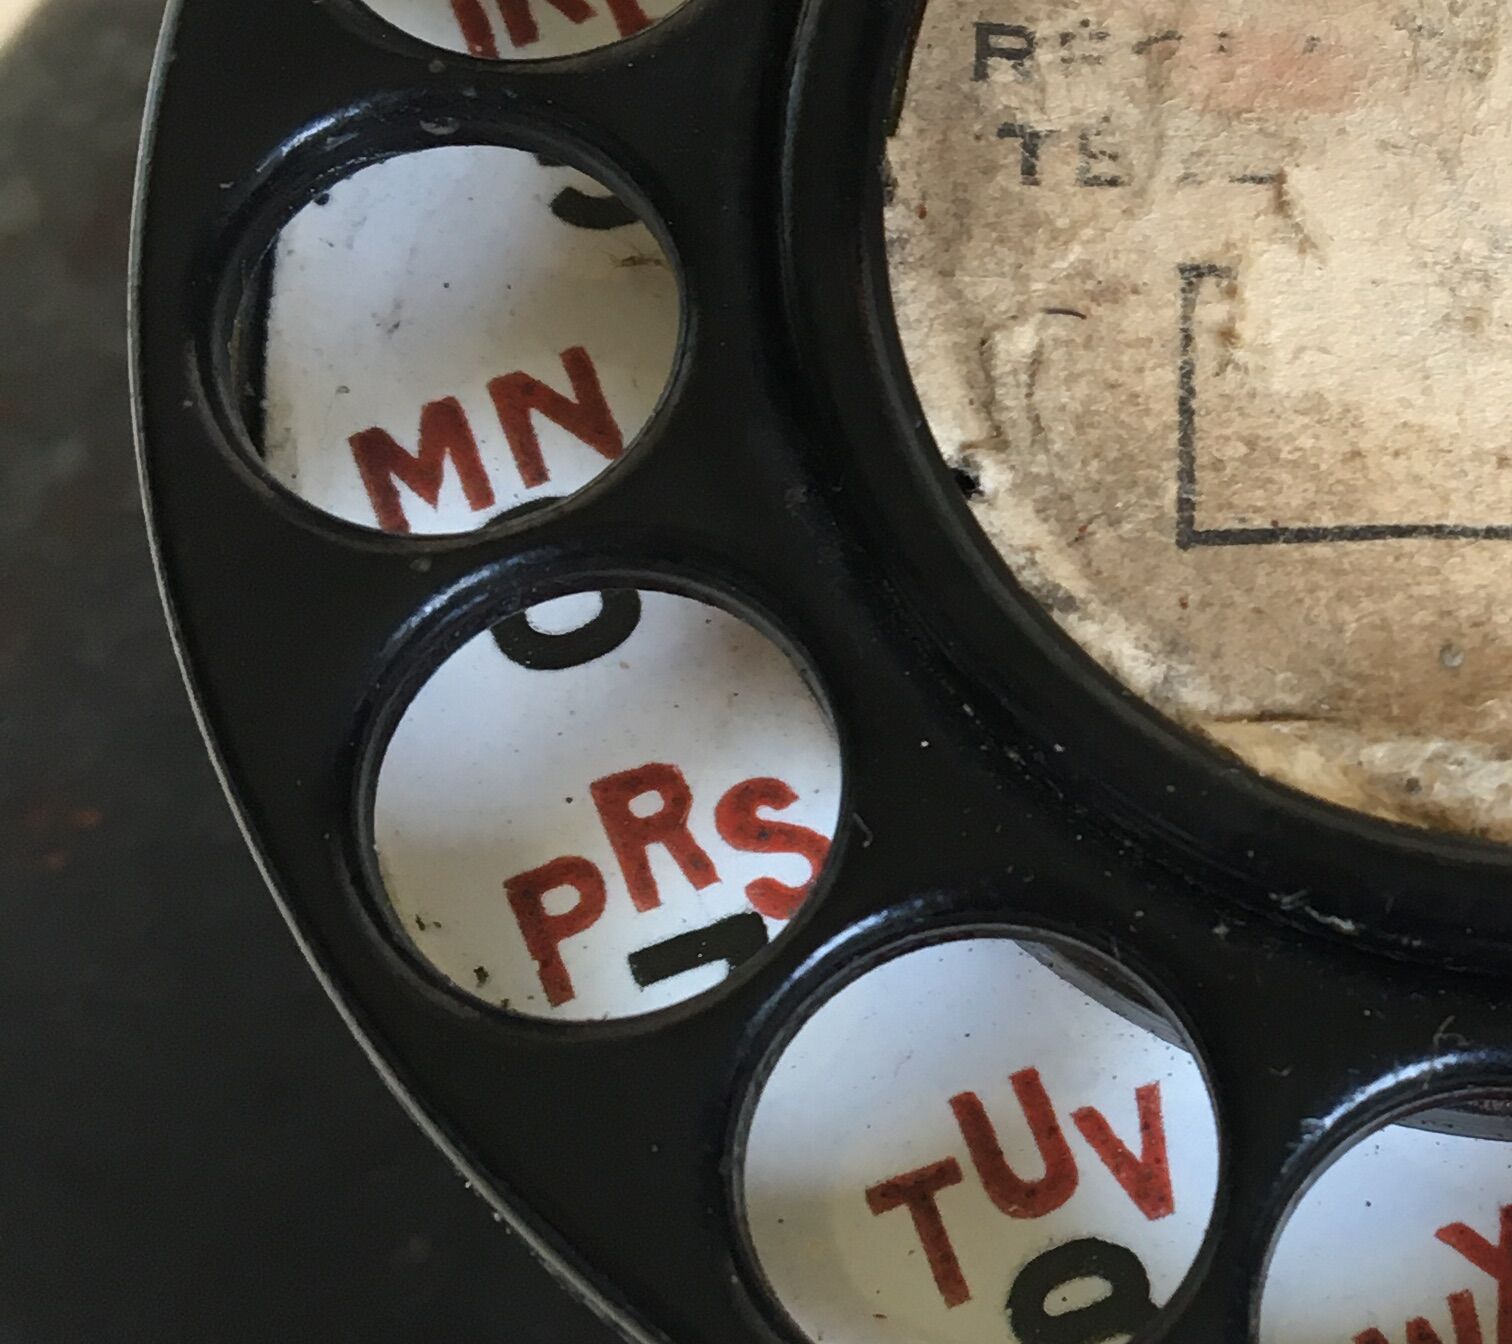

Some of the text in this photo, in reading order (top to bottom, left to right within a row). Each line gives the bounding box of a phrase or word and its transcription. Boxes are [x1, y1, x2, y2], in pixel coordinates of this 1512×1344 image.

[347, 345, 626, 535] MN
[502, 760, 833, 1007] PRS
[864, 1066, 1177, 1310] TUV
